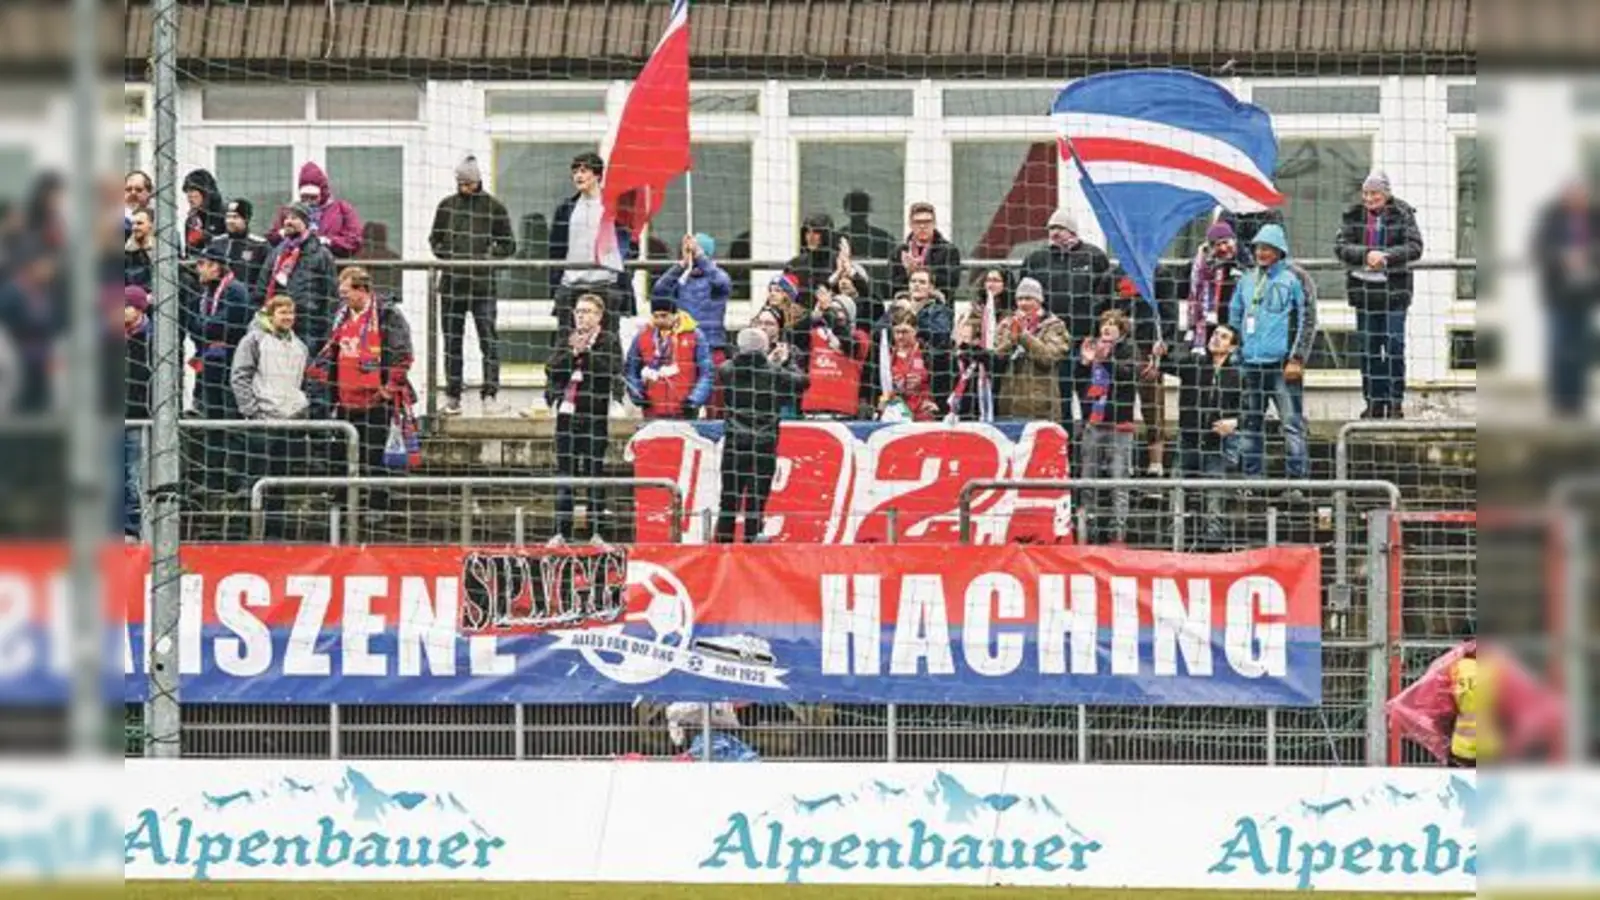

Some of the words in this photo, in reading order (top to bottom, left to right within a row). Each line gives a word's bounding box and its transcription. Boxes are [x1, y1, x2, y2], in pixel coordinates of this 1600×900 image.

[820, 572, 1288, 679] HACHING
[125, 808, 506, 880] Alpenbauer
[699, 811, 1103, 883] Alpenbauer
[1207, 815, 1476, 889] Alpenb
